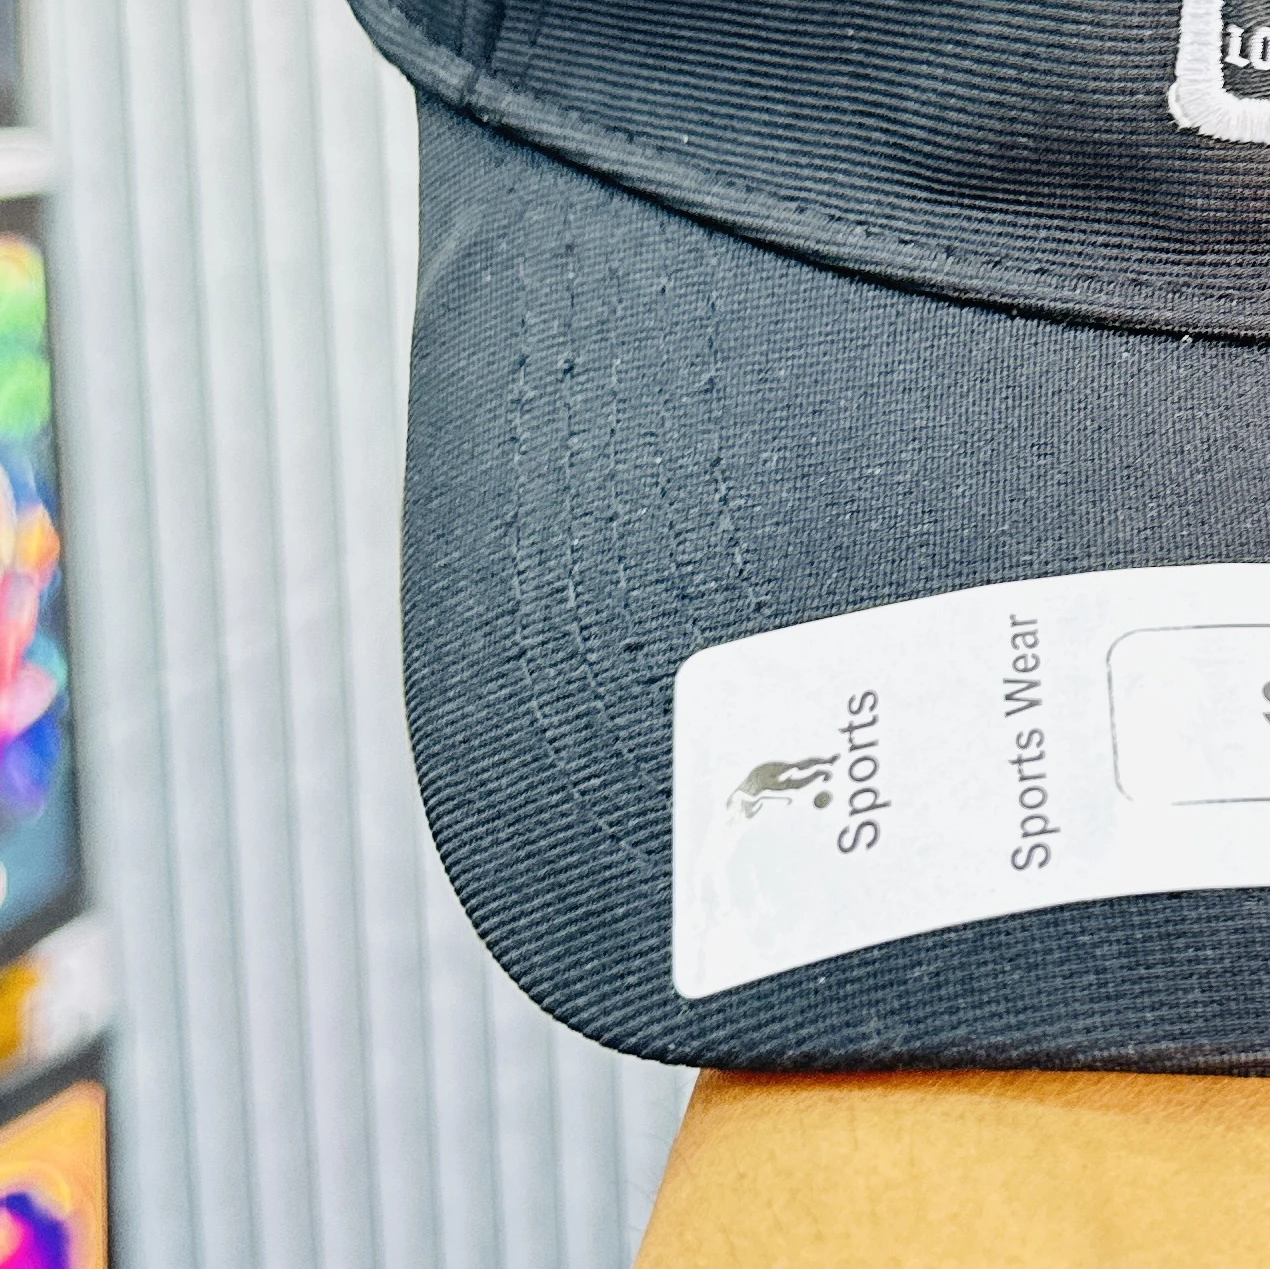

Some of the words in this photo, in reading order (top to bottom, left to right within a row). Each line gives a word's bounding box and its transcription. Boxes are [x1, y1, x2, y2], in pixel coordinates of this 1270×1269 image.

[1002, 613, 1043, 718] Wear
[837, 689, 892, 854] Sports
[1007, 728, 1061, 871] Sports
